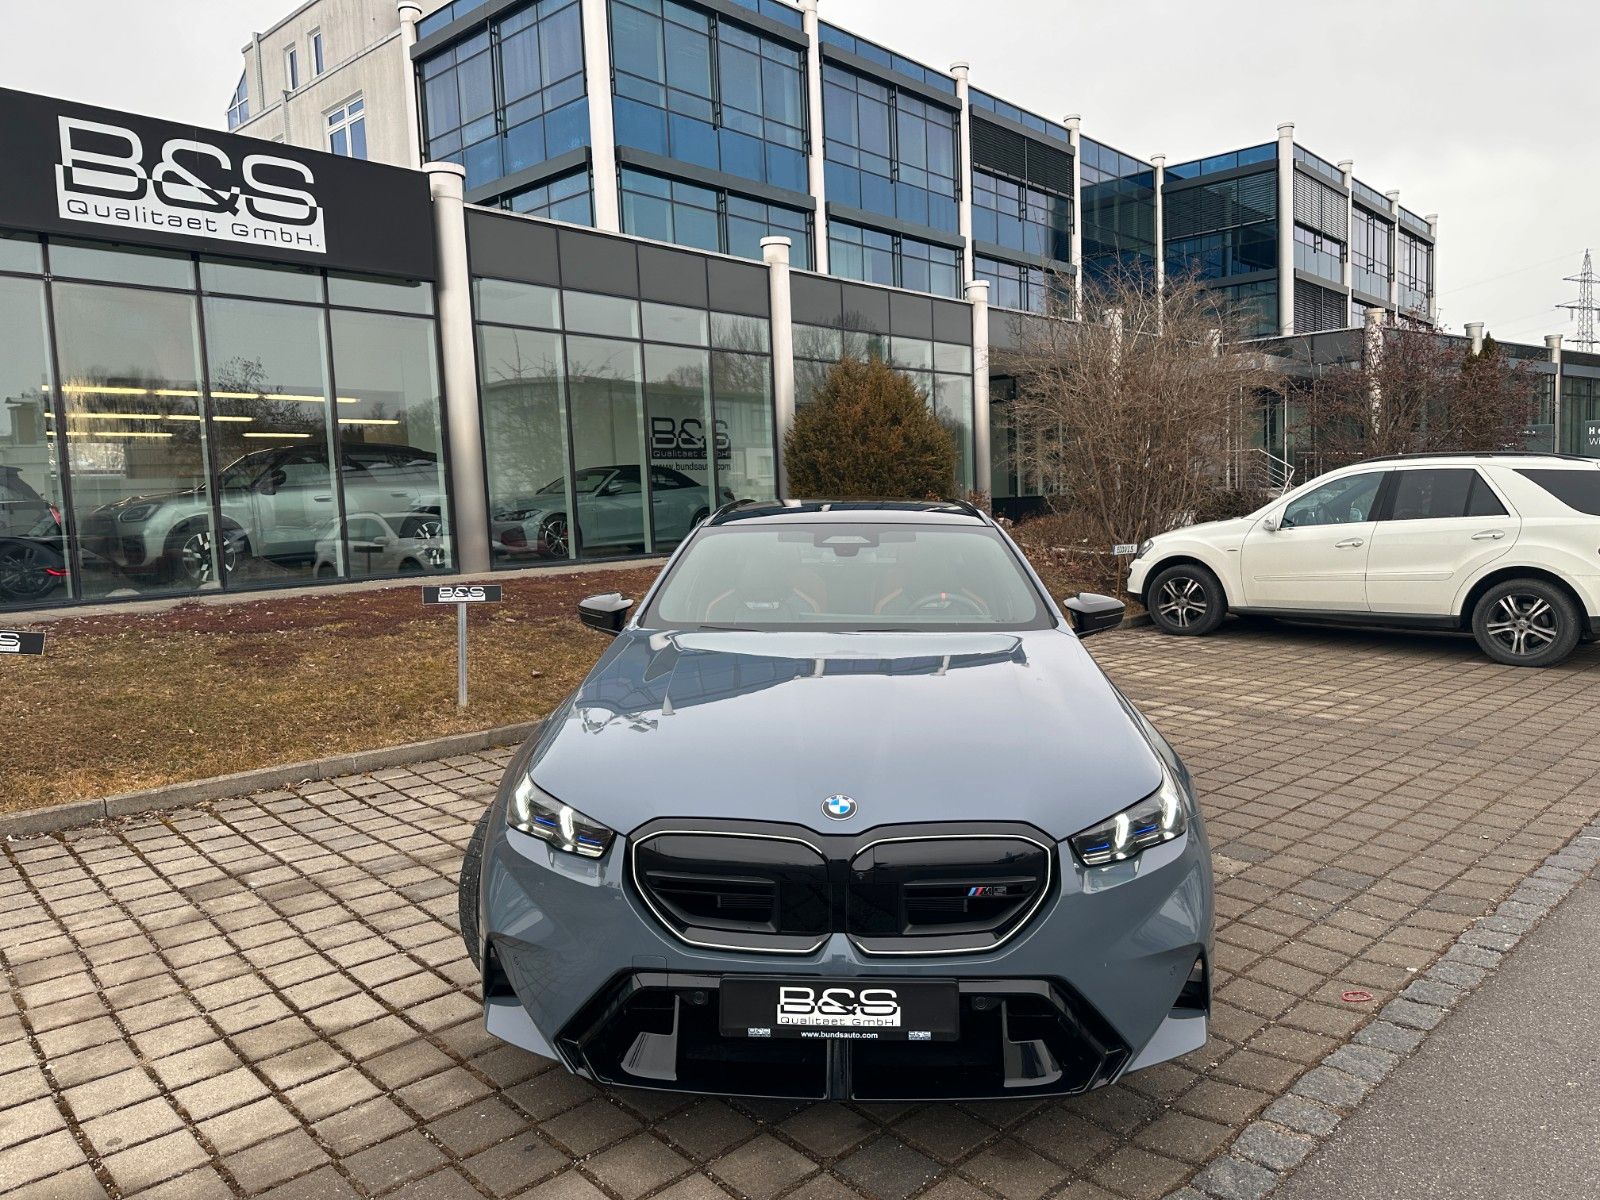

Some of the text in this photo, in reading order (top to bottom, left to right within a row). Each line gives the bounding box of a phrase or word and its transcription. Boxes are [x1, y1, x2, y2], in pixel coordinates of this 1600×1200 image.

[58, 115, 318, 226] B&S
[67, 199, 218, 232] Qualitaet
[1588, 426, 1600, 435] H
[439, 586, 484, 598] B&S
[779, 986, 898, 1016] B&S
[780, 1016, 846, 1025] Qualitaet
[800, 1031, 878, 1039] www.bundsauto.com
